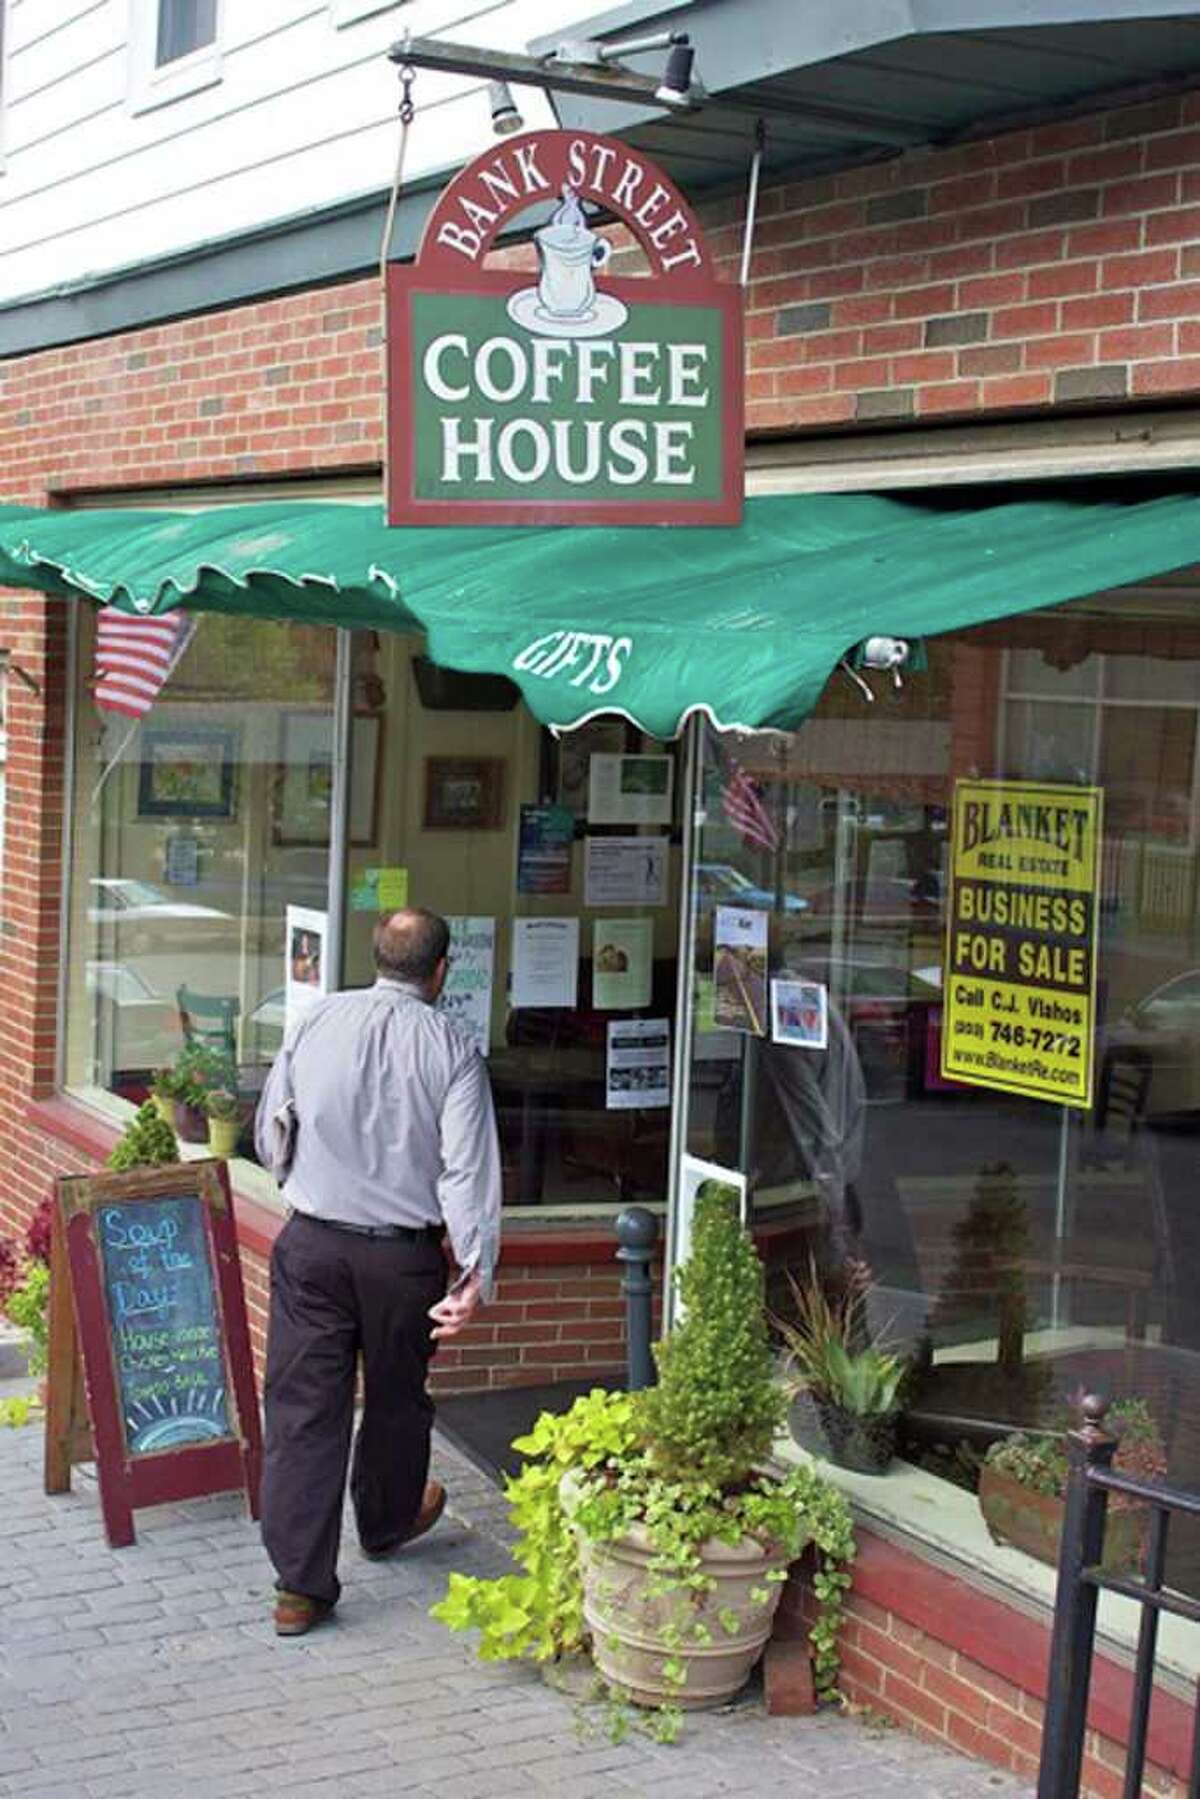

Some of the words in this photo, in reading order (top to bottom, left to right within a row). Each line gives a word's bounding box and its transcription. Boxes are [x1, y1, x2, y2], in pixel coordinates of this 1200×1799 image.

[436, 141, 551, 261] BANK
[567, 139, 702, 272] STREET
[423, 334, 711, 408] COFFEE
[440, 417, 696, 485] HOUSE
[513, 630, 633, 695] GIFTS
[962, 801, 1088, 863] BLANKET
[977, 852, 1012, 870] REAL
[958, 886, 1086, 935] BUSINESS
[956, 932, 1005, 973] FOR
[1019, 941, 1086, 985] SALE
[955, 984, 985, 1007] Call
[991, 991, 1020, 1013] C.J.
[990, 1020, 1080, 1058] 746-7272
[104, 1209, 178, 1250] Soup
